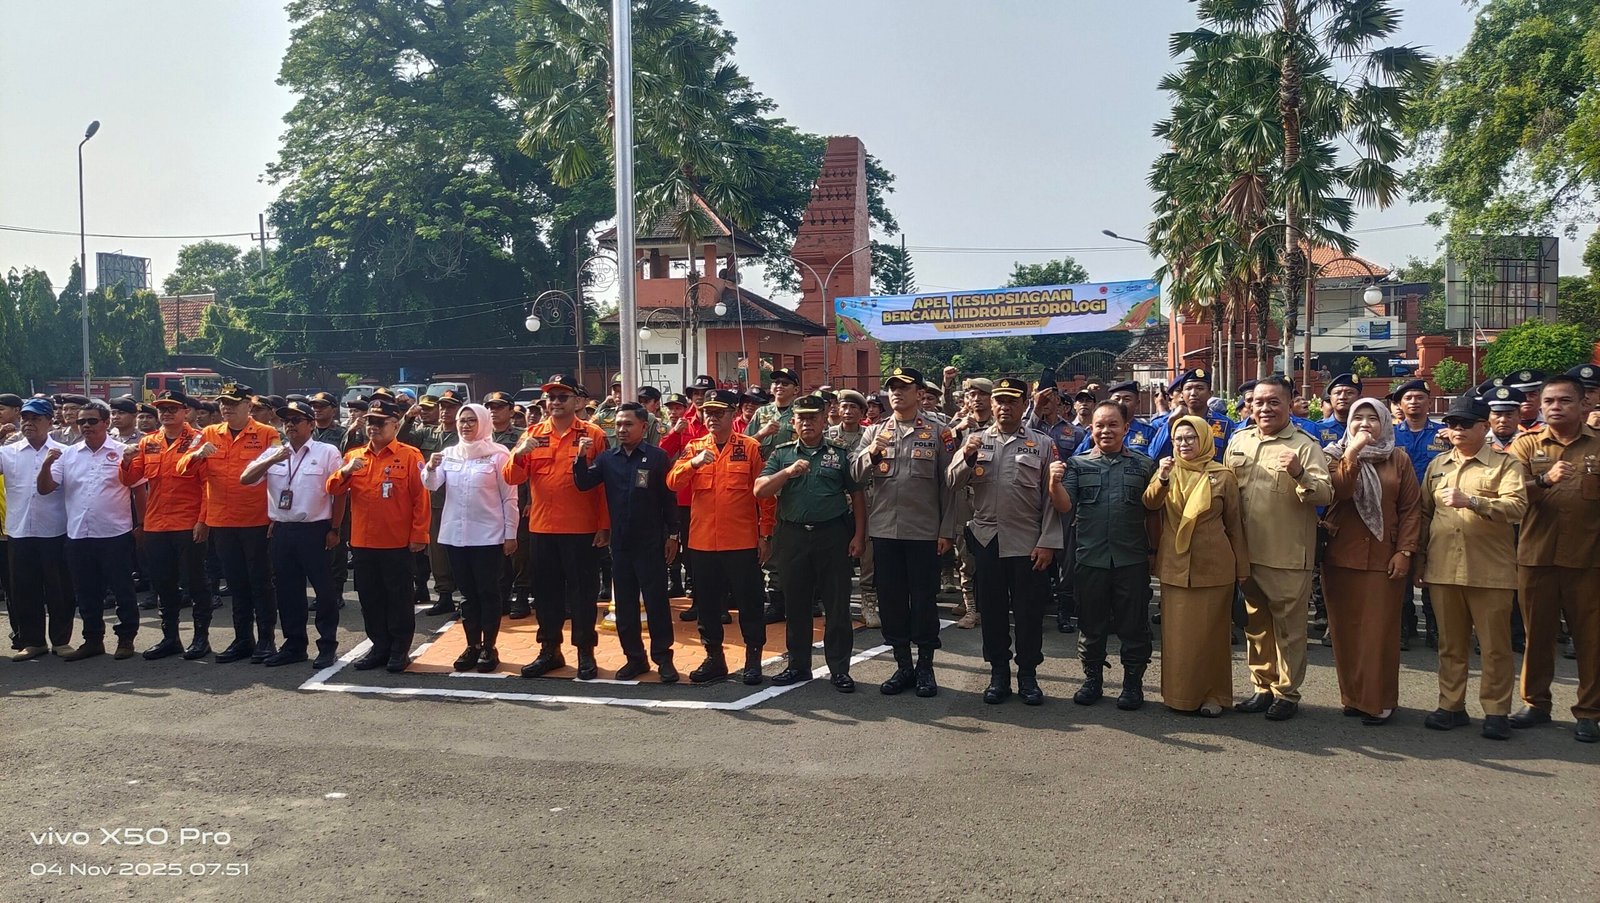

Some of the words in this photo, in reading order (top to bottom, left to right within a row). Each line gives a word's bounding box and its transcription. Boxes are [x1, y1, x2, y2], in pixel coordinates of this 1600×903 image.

[913, 296, 950, 309] APEL
[954, 289, 1072, 307] KESIAPSIAGAAN
[883, 308, 951, 323] BENCANA
[954, 300, 1106, 320] HIDROMETEOROLOGI
[1017, 447, 1040, 455] POLRI
